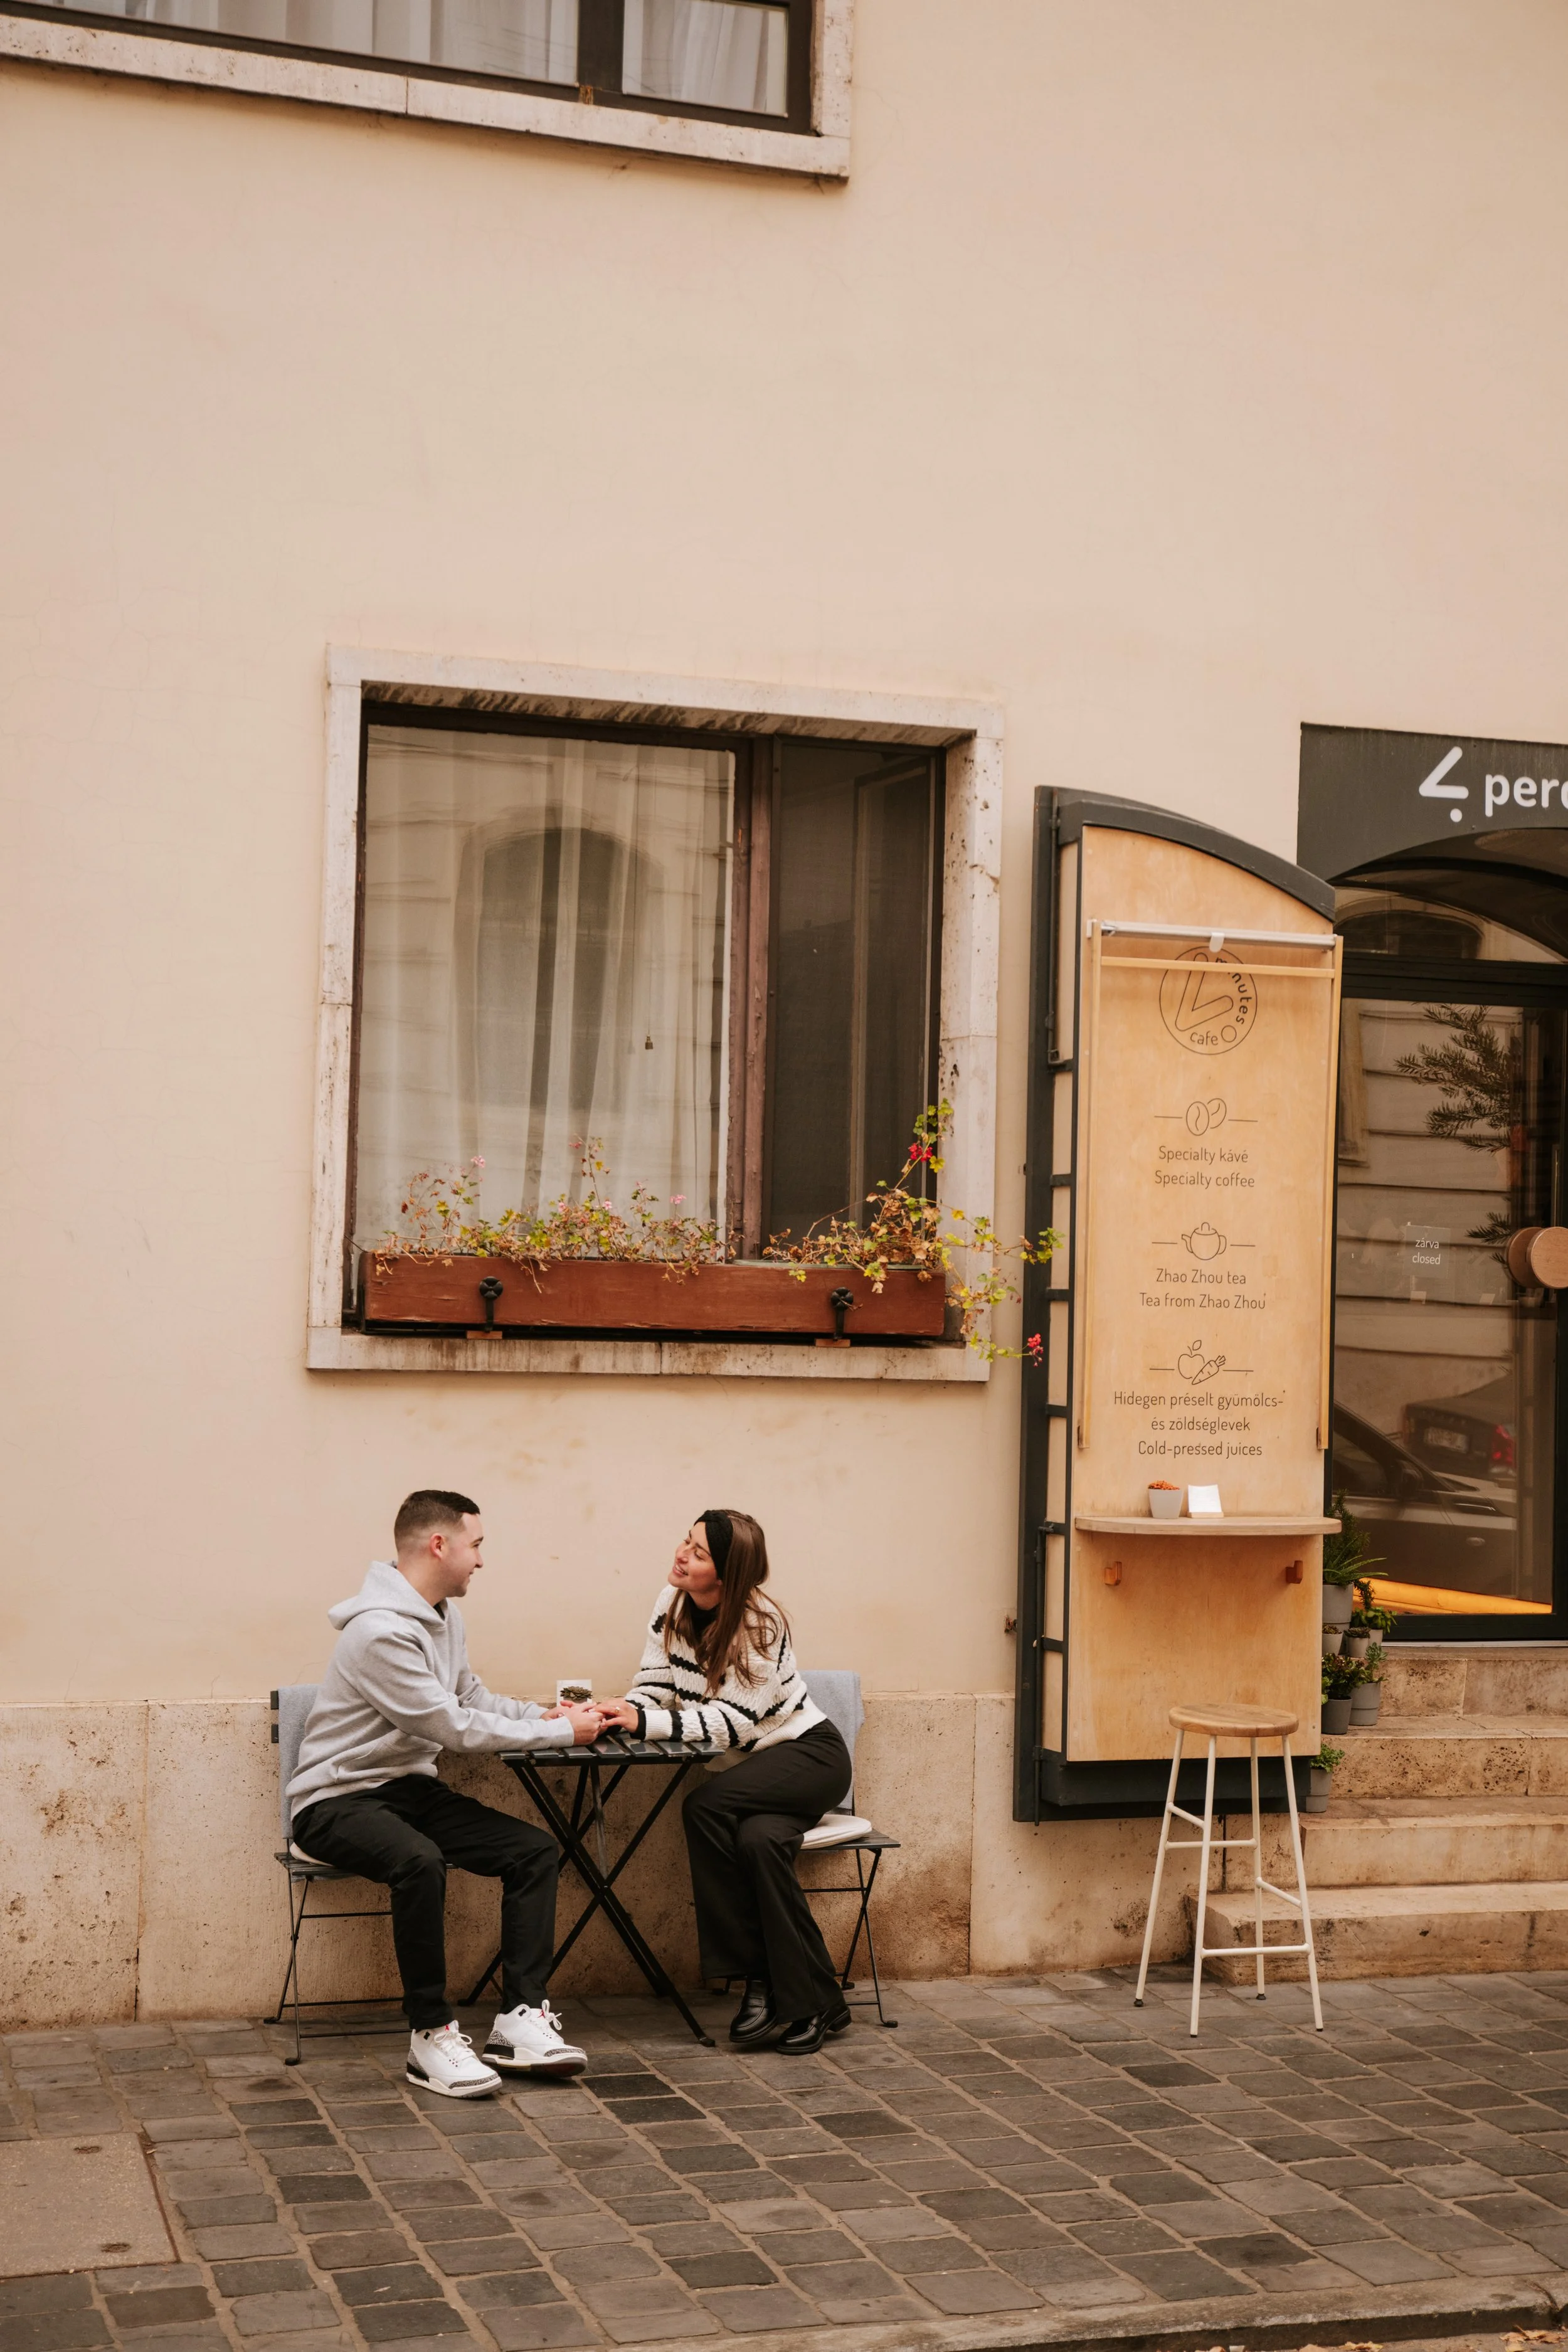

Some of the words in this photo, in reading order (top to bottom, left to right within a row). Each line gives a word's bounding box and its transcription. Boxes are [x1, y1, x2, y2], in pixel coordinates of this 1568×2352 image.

[1216, 957, 1252, 1025] nutes
[1190, 1030, 1219, 1046] cafe
[1158, 1145, 1216, 1166] Specialty
[1219, 1147, 1249, 1163] kávé
[1154, 1169, 1212, 1190] Specialty
[1215, 1172, 1255, 1188] coffee
[1415, 1237, 1439, 1249] zárva
[1412, 1252, 1441, 1265] closed
[1156, 1268, 1187, 1283] Zhao
[1191, 1269, 1223, 1285] Zhou
[1227, 1270, 1246, 1285] tea
[1139, 1292, 1160, 1307] Tea
[1165, 1292, 1195, 1308] from
[1199, 1293, 1230, 1309] Zhao
[1233, 1295, 1266, 1310] Zhou
[1114, 1390, 1166, 1410] Hidegen
[1170, 1391, 1214, 1410] préselt
[1217, 1392, 1284, 1411] gyümölcs-
[1151, 1416, 1165, 1431] és
[1168, 1416, 1251, 1435] zöldséglevek
[1138, 1439, 1223, 1459] Cold-pressed
[1226, 1442, 1263, 1459] juices
